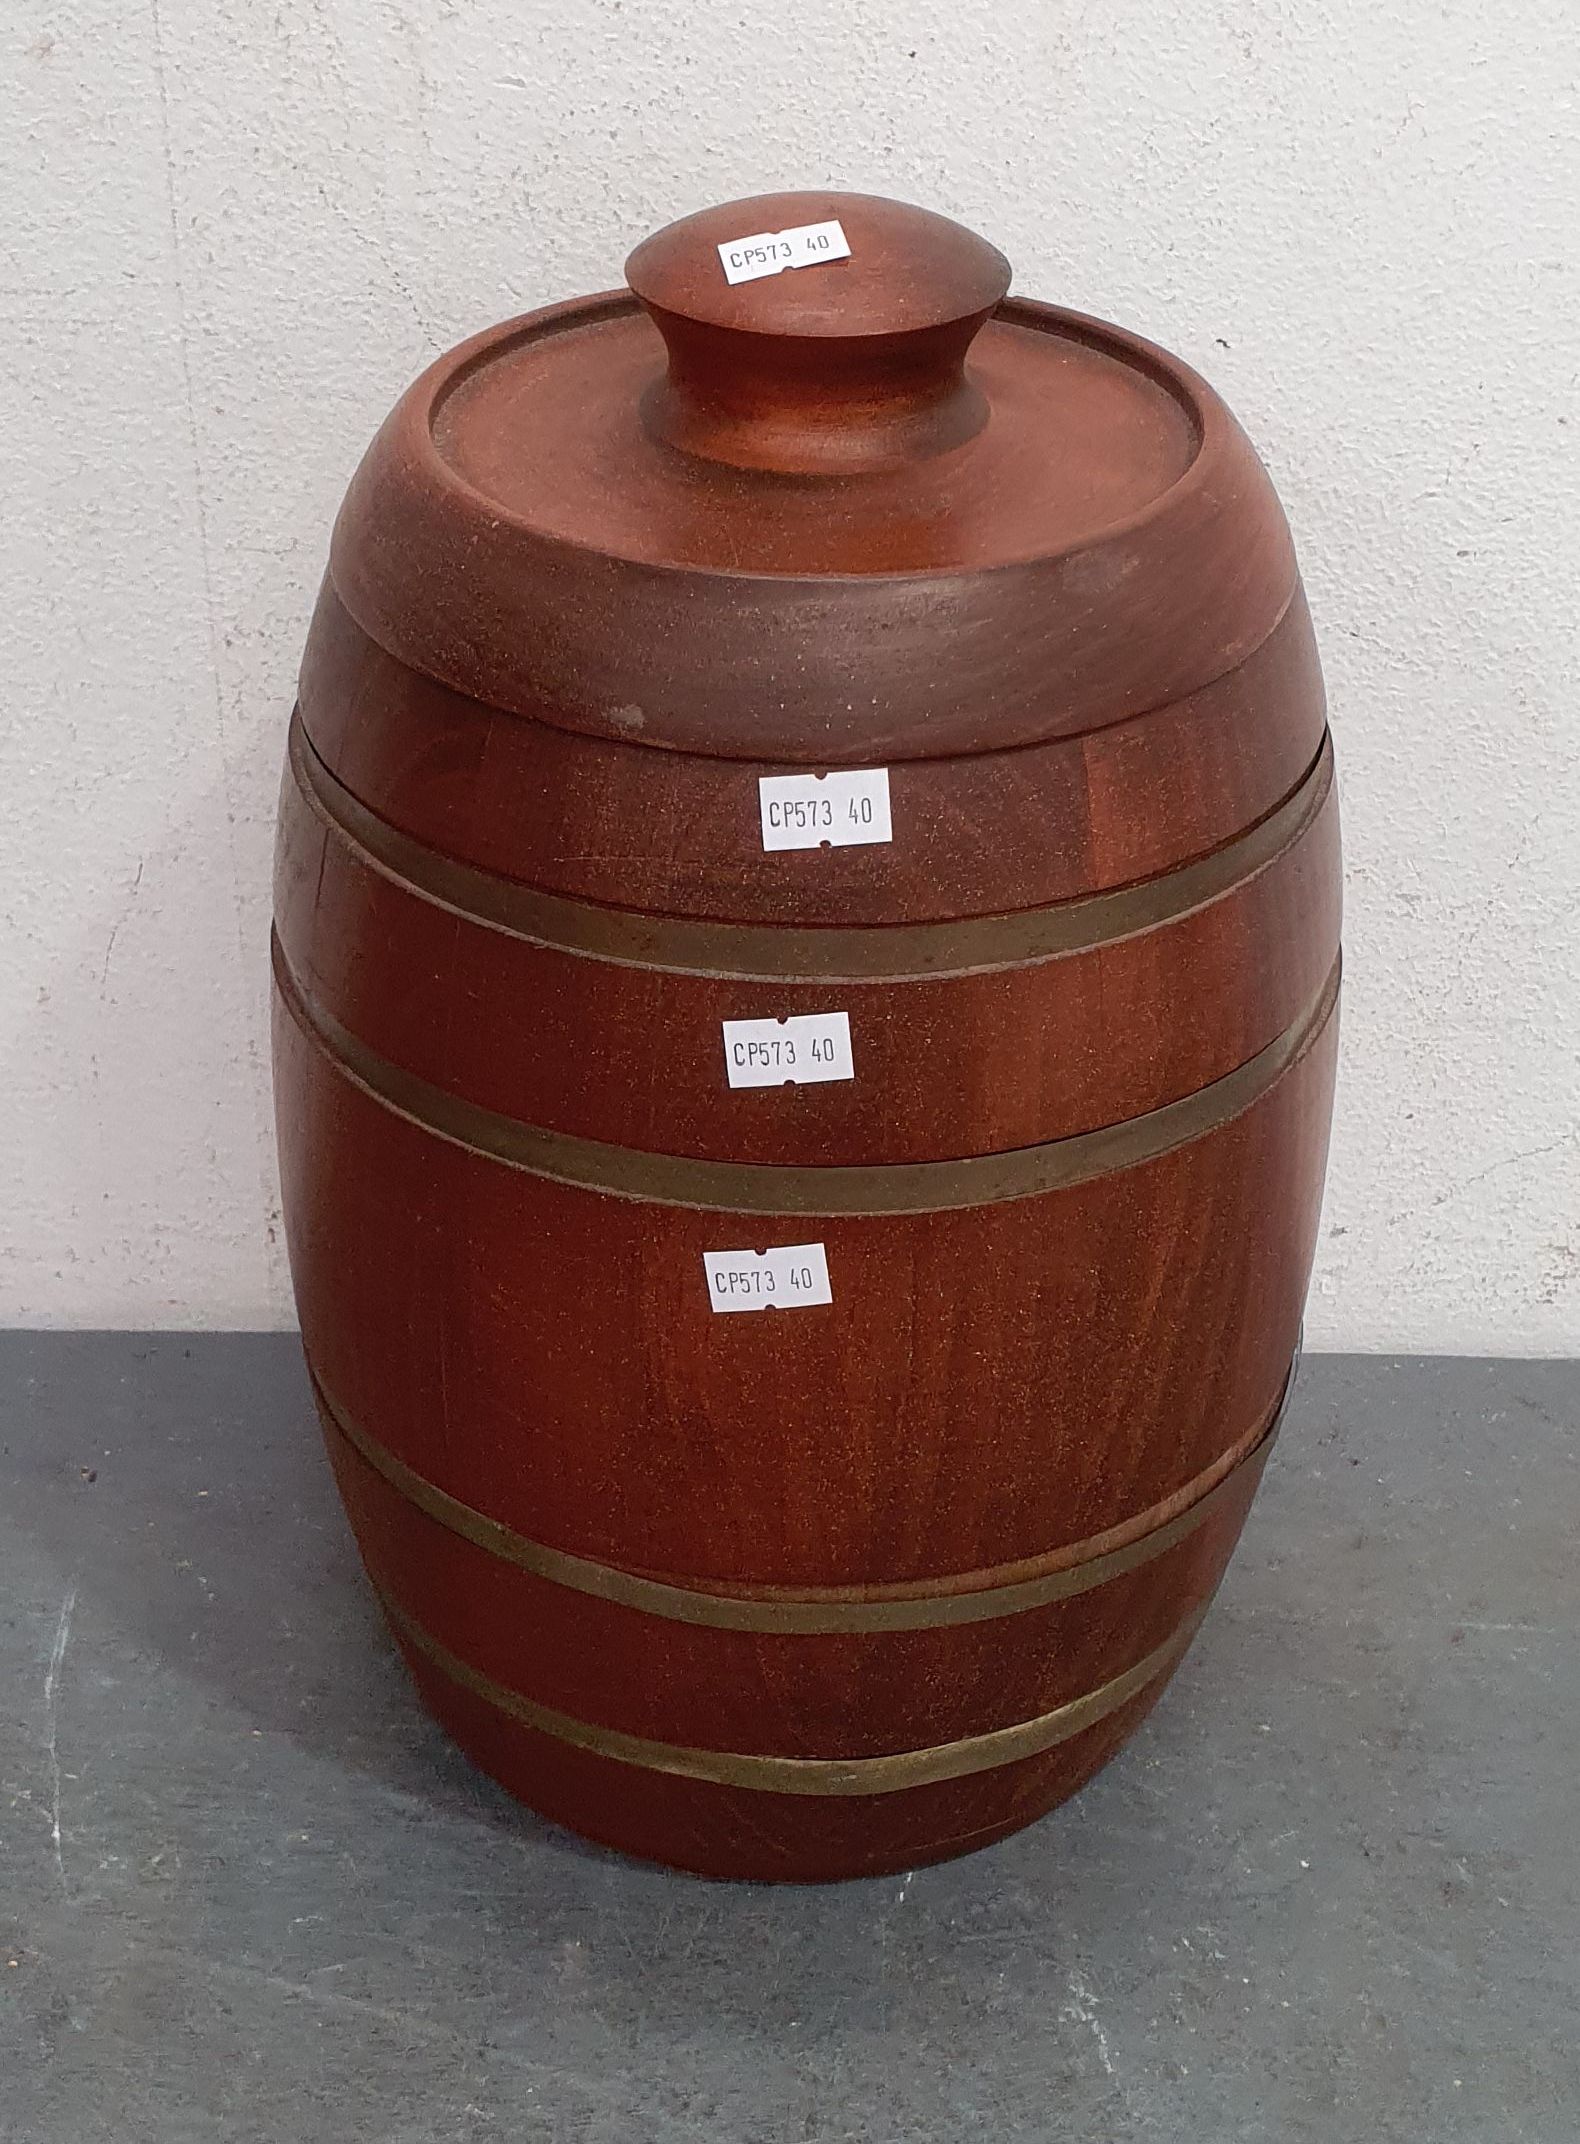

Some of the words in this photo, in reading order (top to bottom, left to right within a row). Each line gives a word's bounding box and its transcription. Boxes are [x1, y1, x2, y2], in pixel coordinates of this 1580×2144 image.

[730, 242, 792, 268] CP573
[806, 235, 830, 251] 40
[769, 800, 832, 828] CP573
[848, 797, 872, 824] 40
[733, 1040, 796, 1067] CP573
[811, 1038, 834, 1062] 40
[715, 1270, 776, 1294] CP573
[790, 1267, 813, 1290] 40
